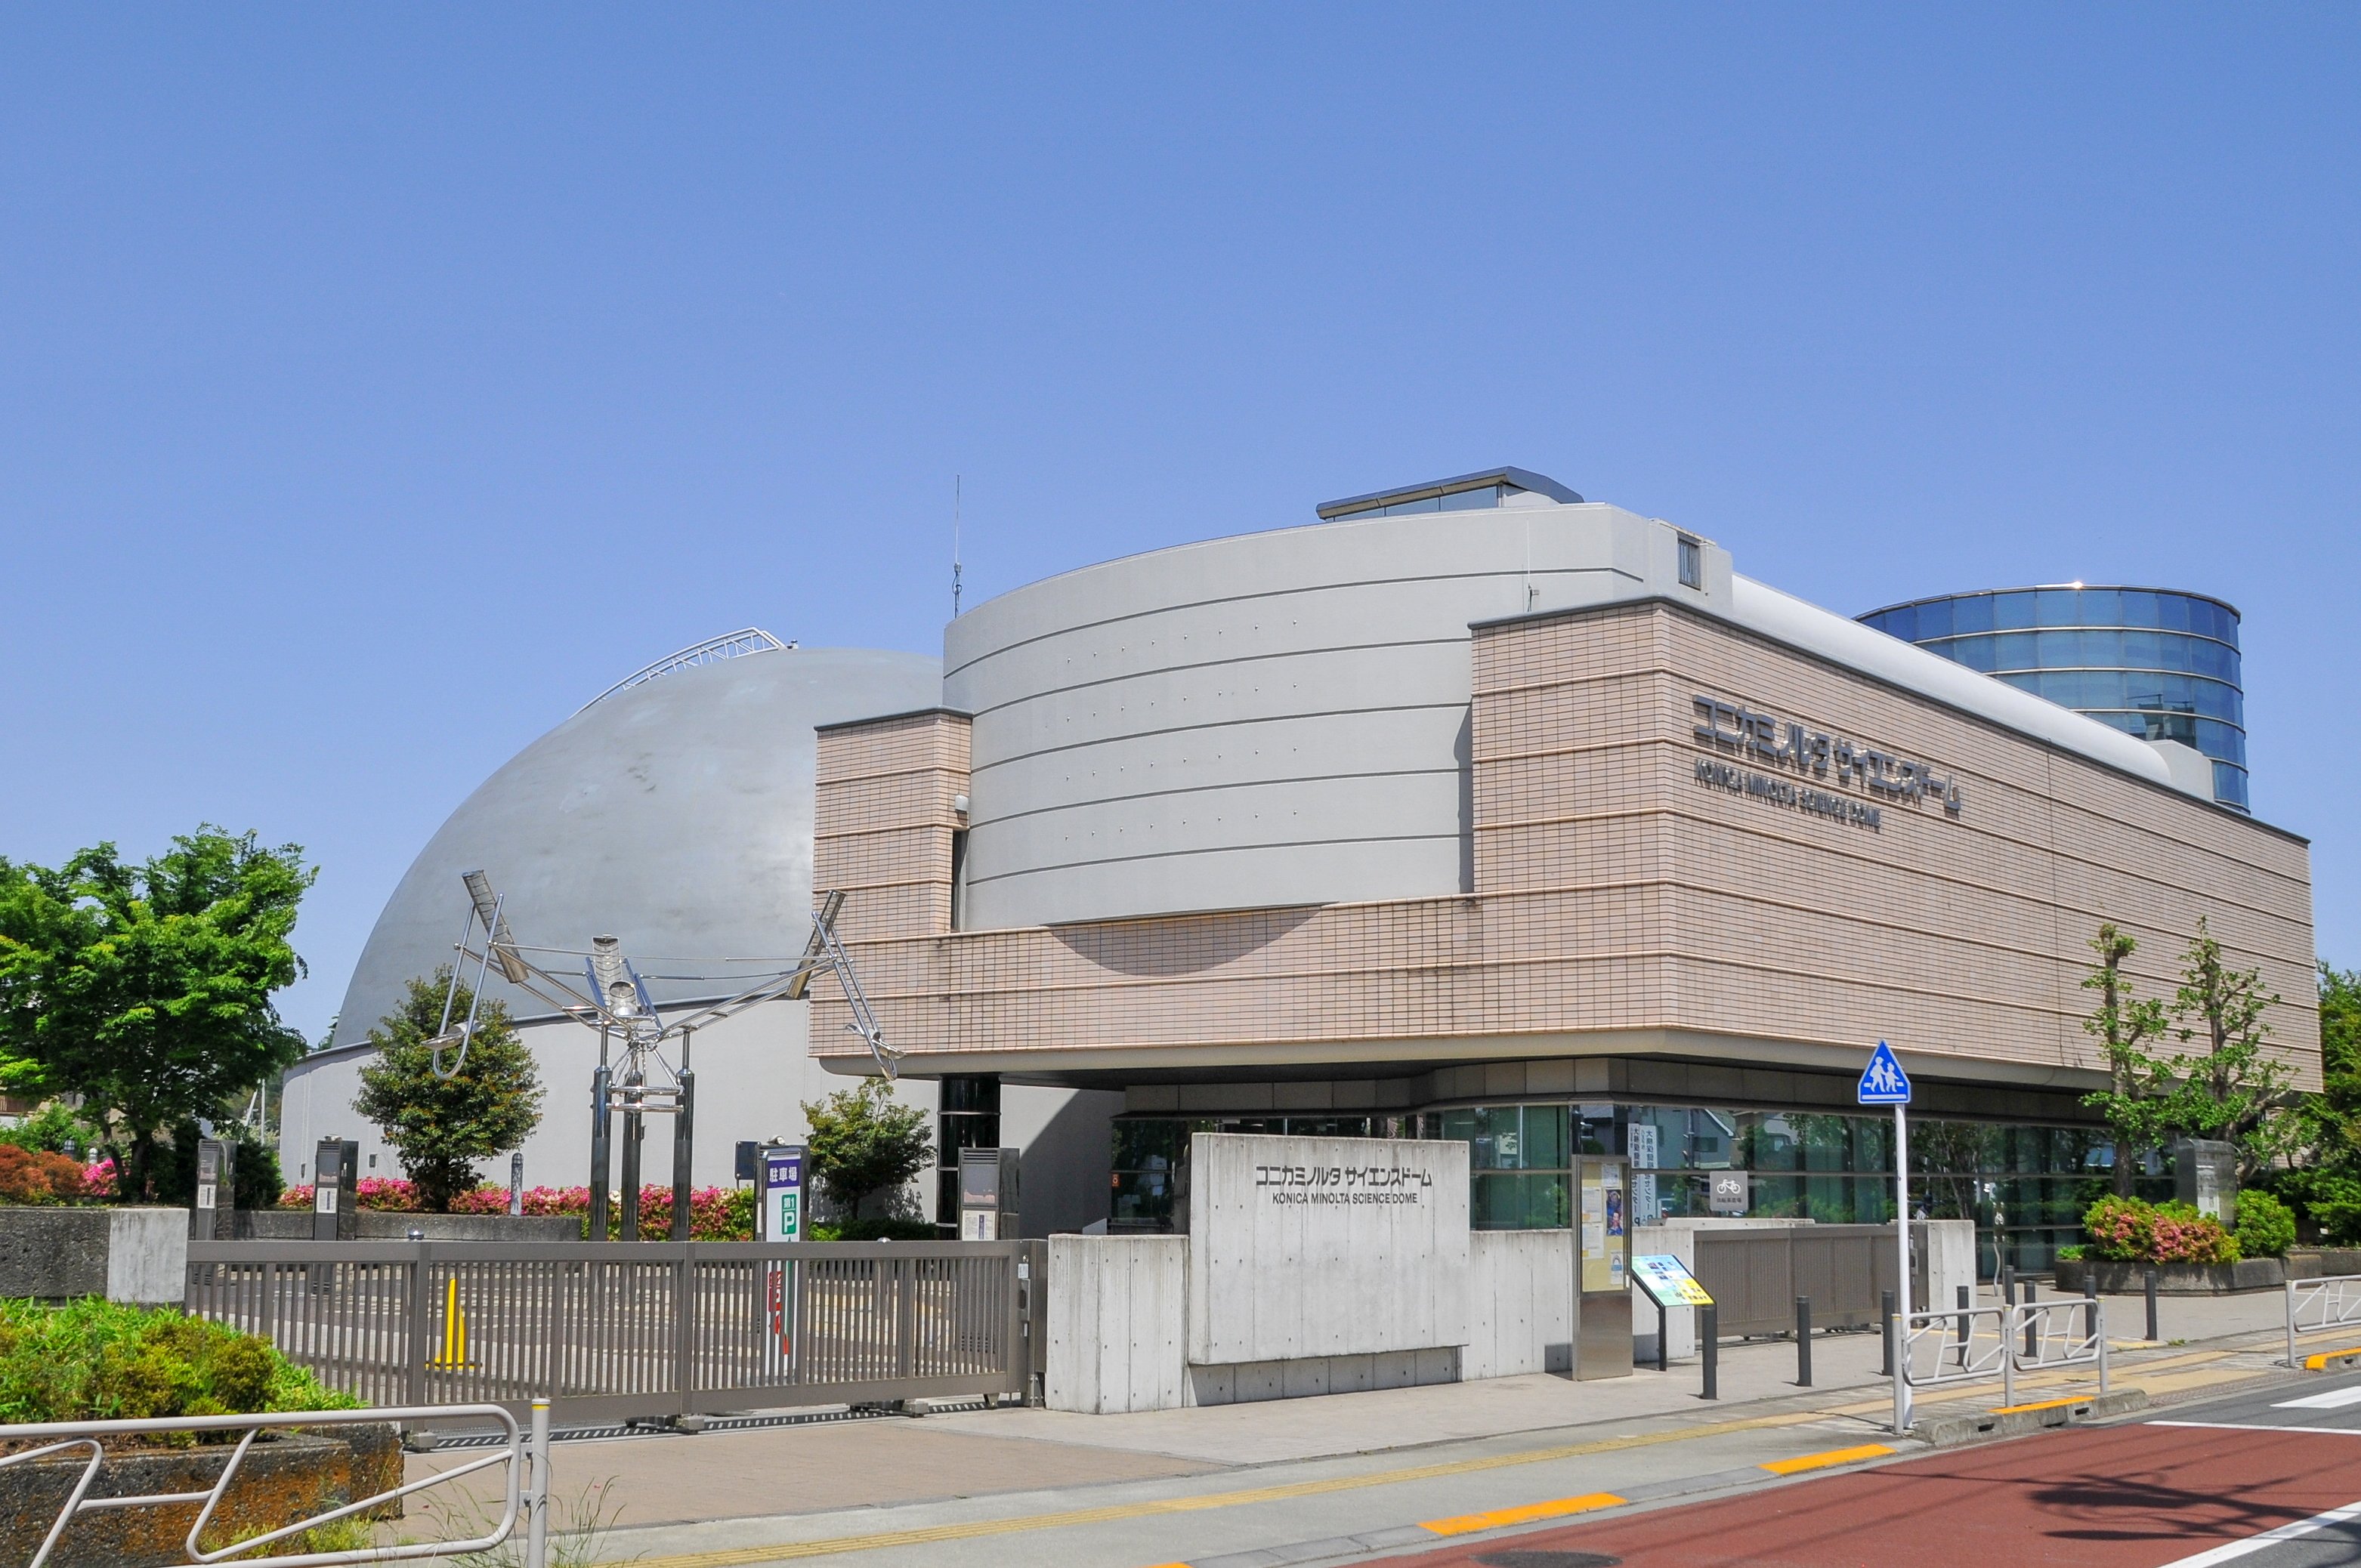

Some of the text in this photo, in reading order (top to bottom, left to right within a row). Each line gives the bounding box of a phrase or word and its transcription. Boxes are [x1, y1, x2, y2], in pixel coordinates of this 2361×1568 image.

[1693, 694, 1961, 811] コニカミノルタ サイエンスドーム
[1694, 758, 1881, 829] KONICA MINOLTA SCIENCE DOME
[769, 1166, 797, 1183] 駐車場
[1256, 1165, 1432, 1187] コニカミノルタ サイエンスドーム
[1272, 1192, 1418, 1204] KONICA MINOLTA SCIENCE DOME
[783, 1211, 795, 1233] P
